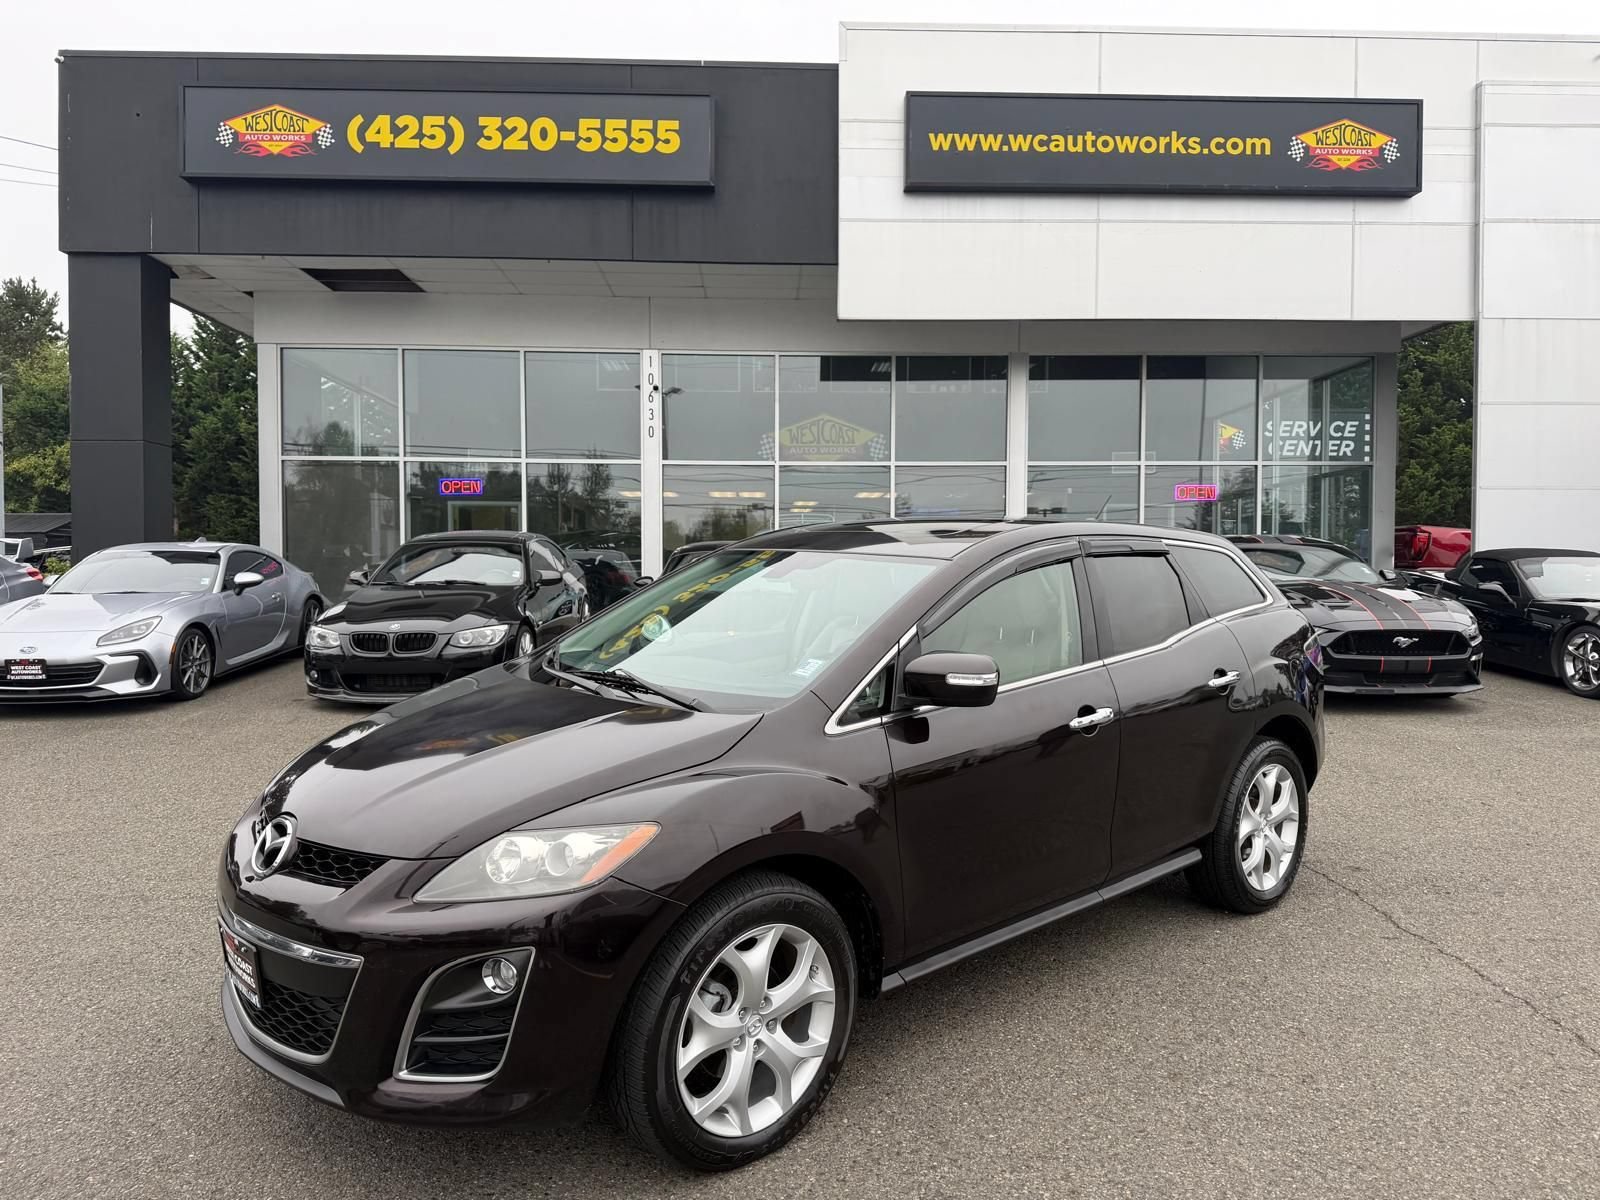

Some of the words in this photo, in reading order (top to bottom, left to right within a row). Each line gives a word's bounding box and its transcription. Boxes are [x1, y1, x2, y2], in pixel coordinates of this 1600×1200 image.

[346, 114, 465, 155] (425)
[476, 116, 681, 154] 320-5555
[928, 131, 1272, 156] www.wcautoworks.com
[1264, 420, 1359, 437] SERVCE
[789, 446, 817, 454] AUTO
[820, 446, 857, 454] WORKS
[441, 480, 481, 494] OPEN
[1178, 486, 1214, 499] OPEN
